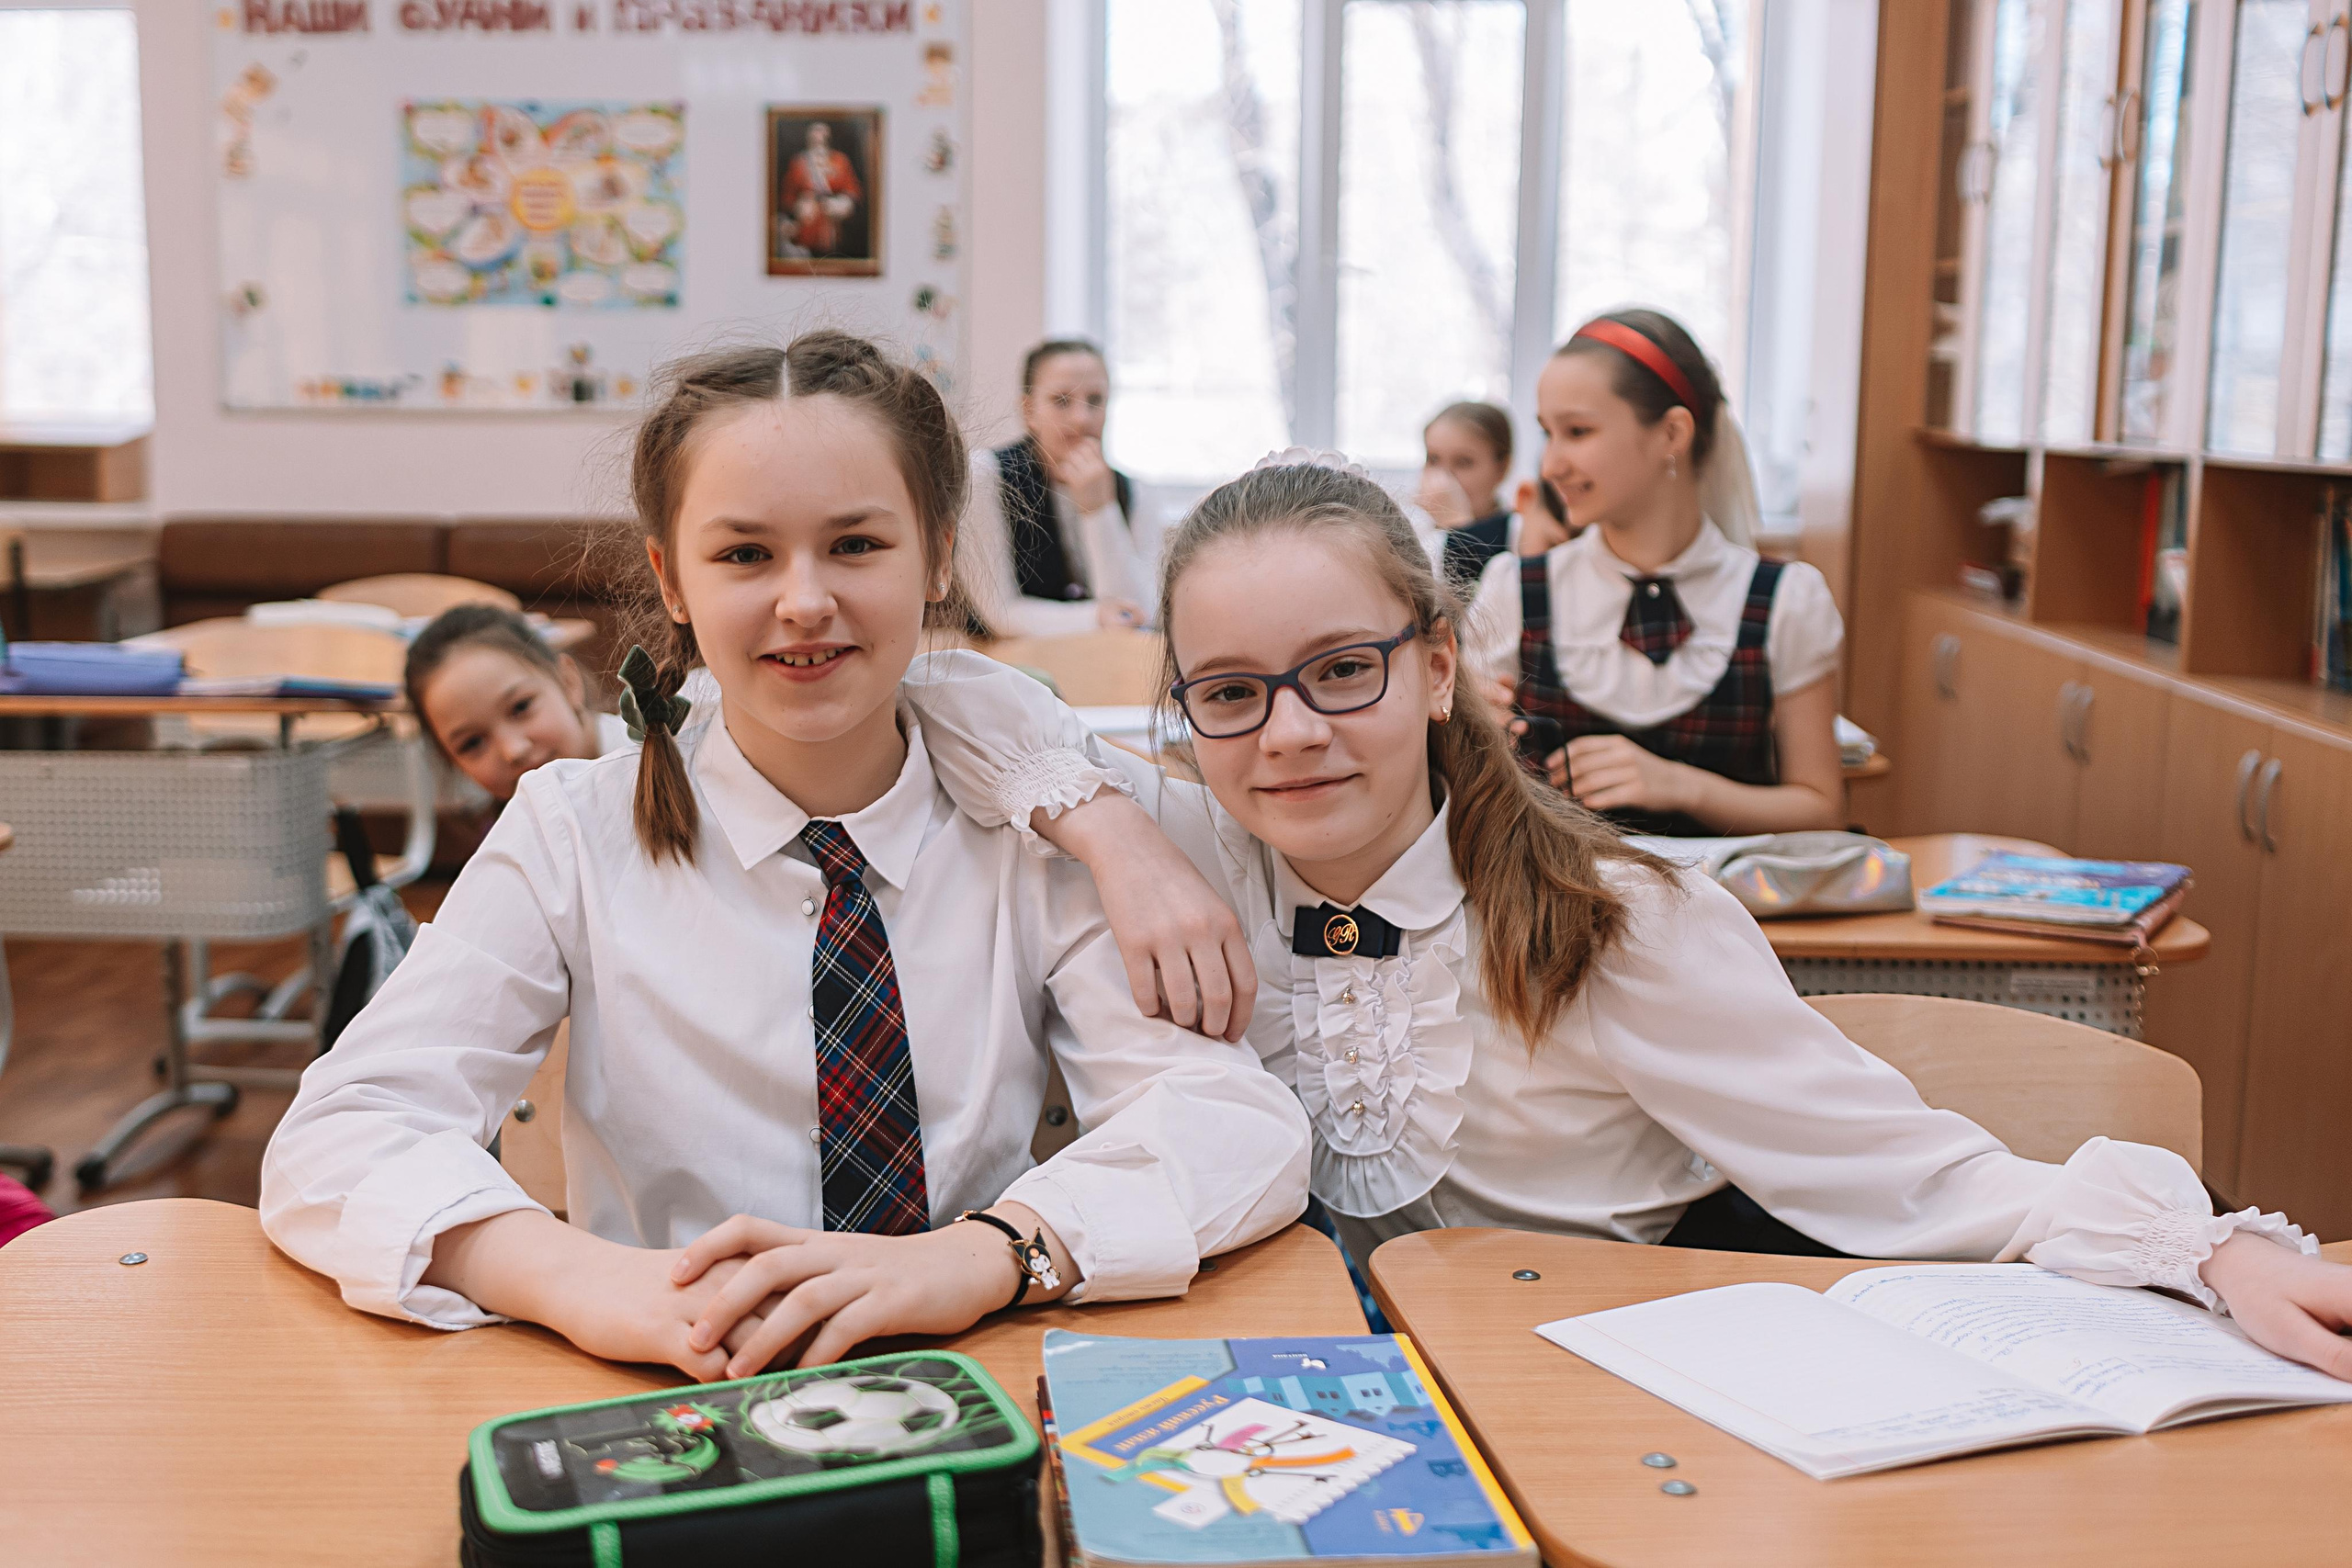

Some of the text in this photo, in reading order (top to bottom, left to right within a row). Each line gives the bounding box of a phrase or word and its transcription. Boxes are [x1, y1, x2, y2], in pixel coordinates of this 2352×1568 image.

[243, 0, 369, 33] НАШИ
[1158, 1394, 1230, 1430] Русский
[1388, 1507, 1425, 1537] 4
